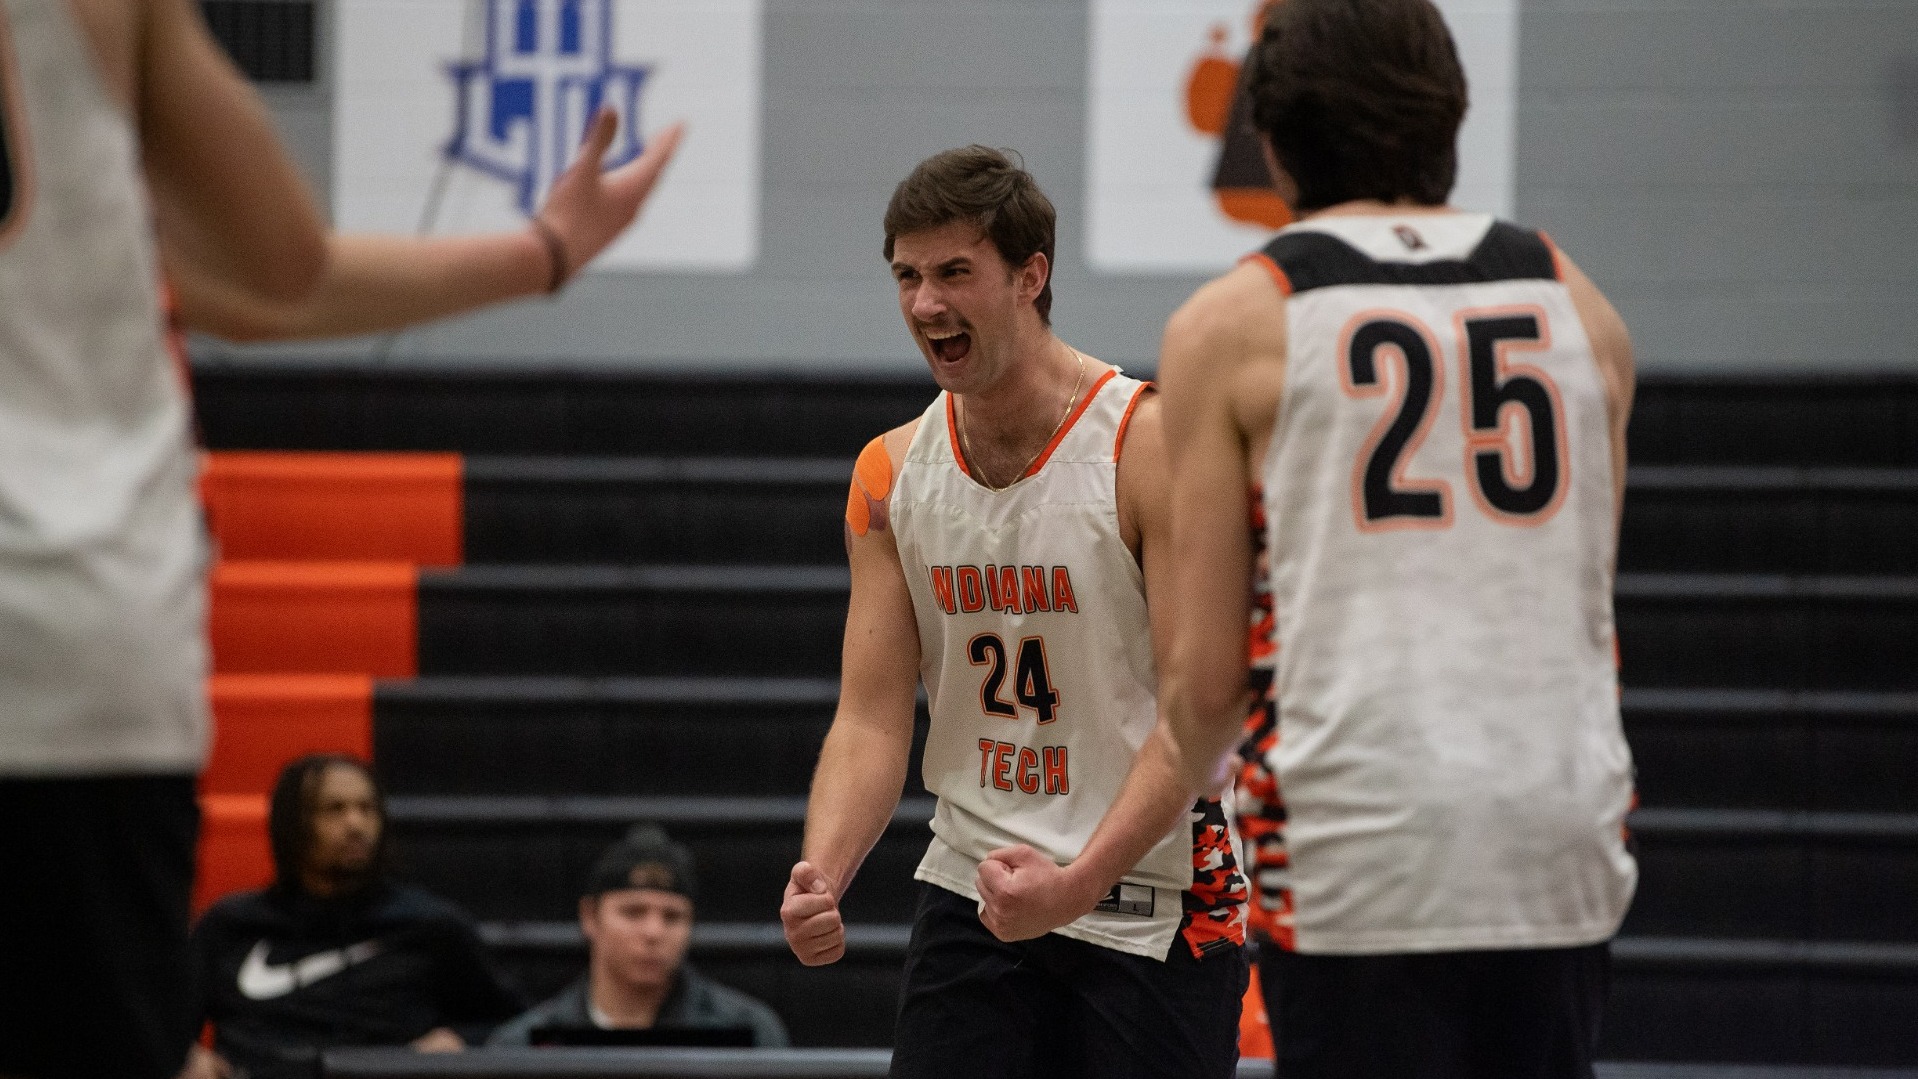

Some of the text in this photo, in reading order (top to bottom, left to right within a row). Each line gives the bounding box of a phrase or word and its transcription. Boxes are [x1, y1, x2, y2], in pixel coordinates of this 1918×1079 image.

[1340, 305, 1571, 532] 25
[926, 565, 1078, 615] NDIANA
[967, 633, 1060, 725] 24
[979, 738, 1069, 795] TECH
